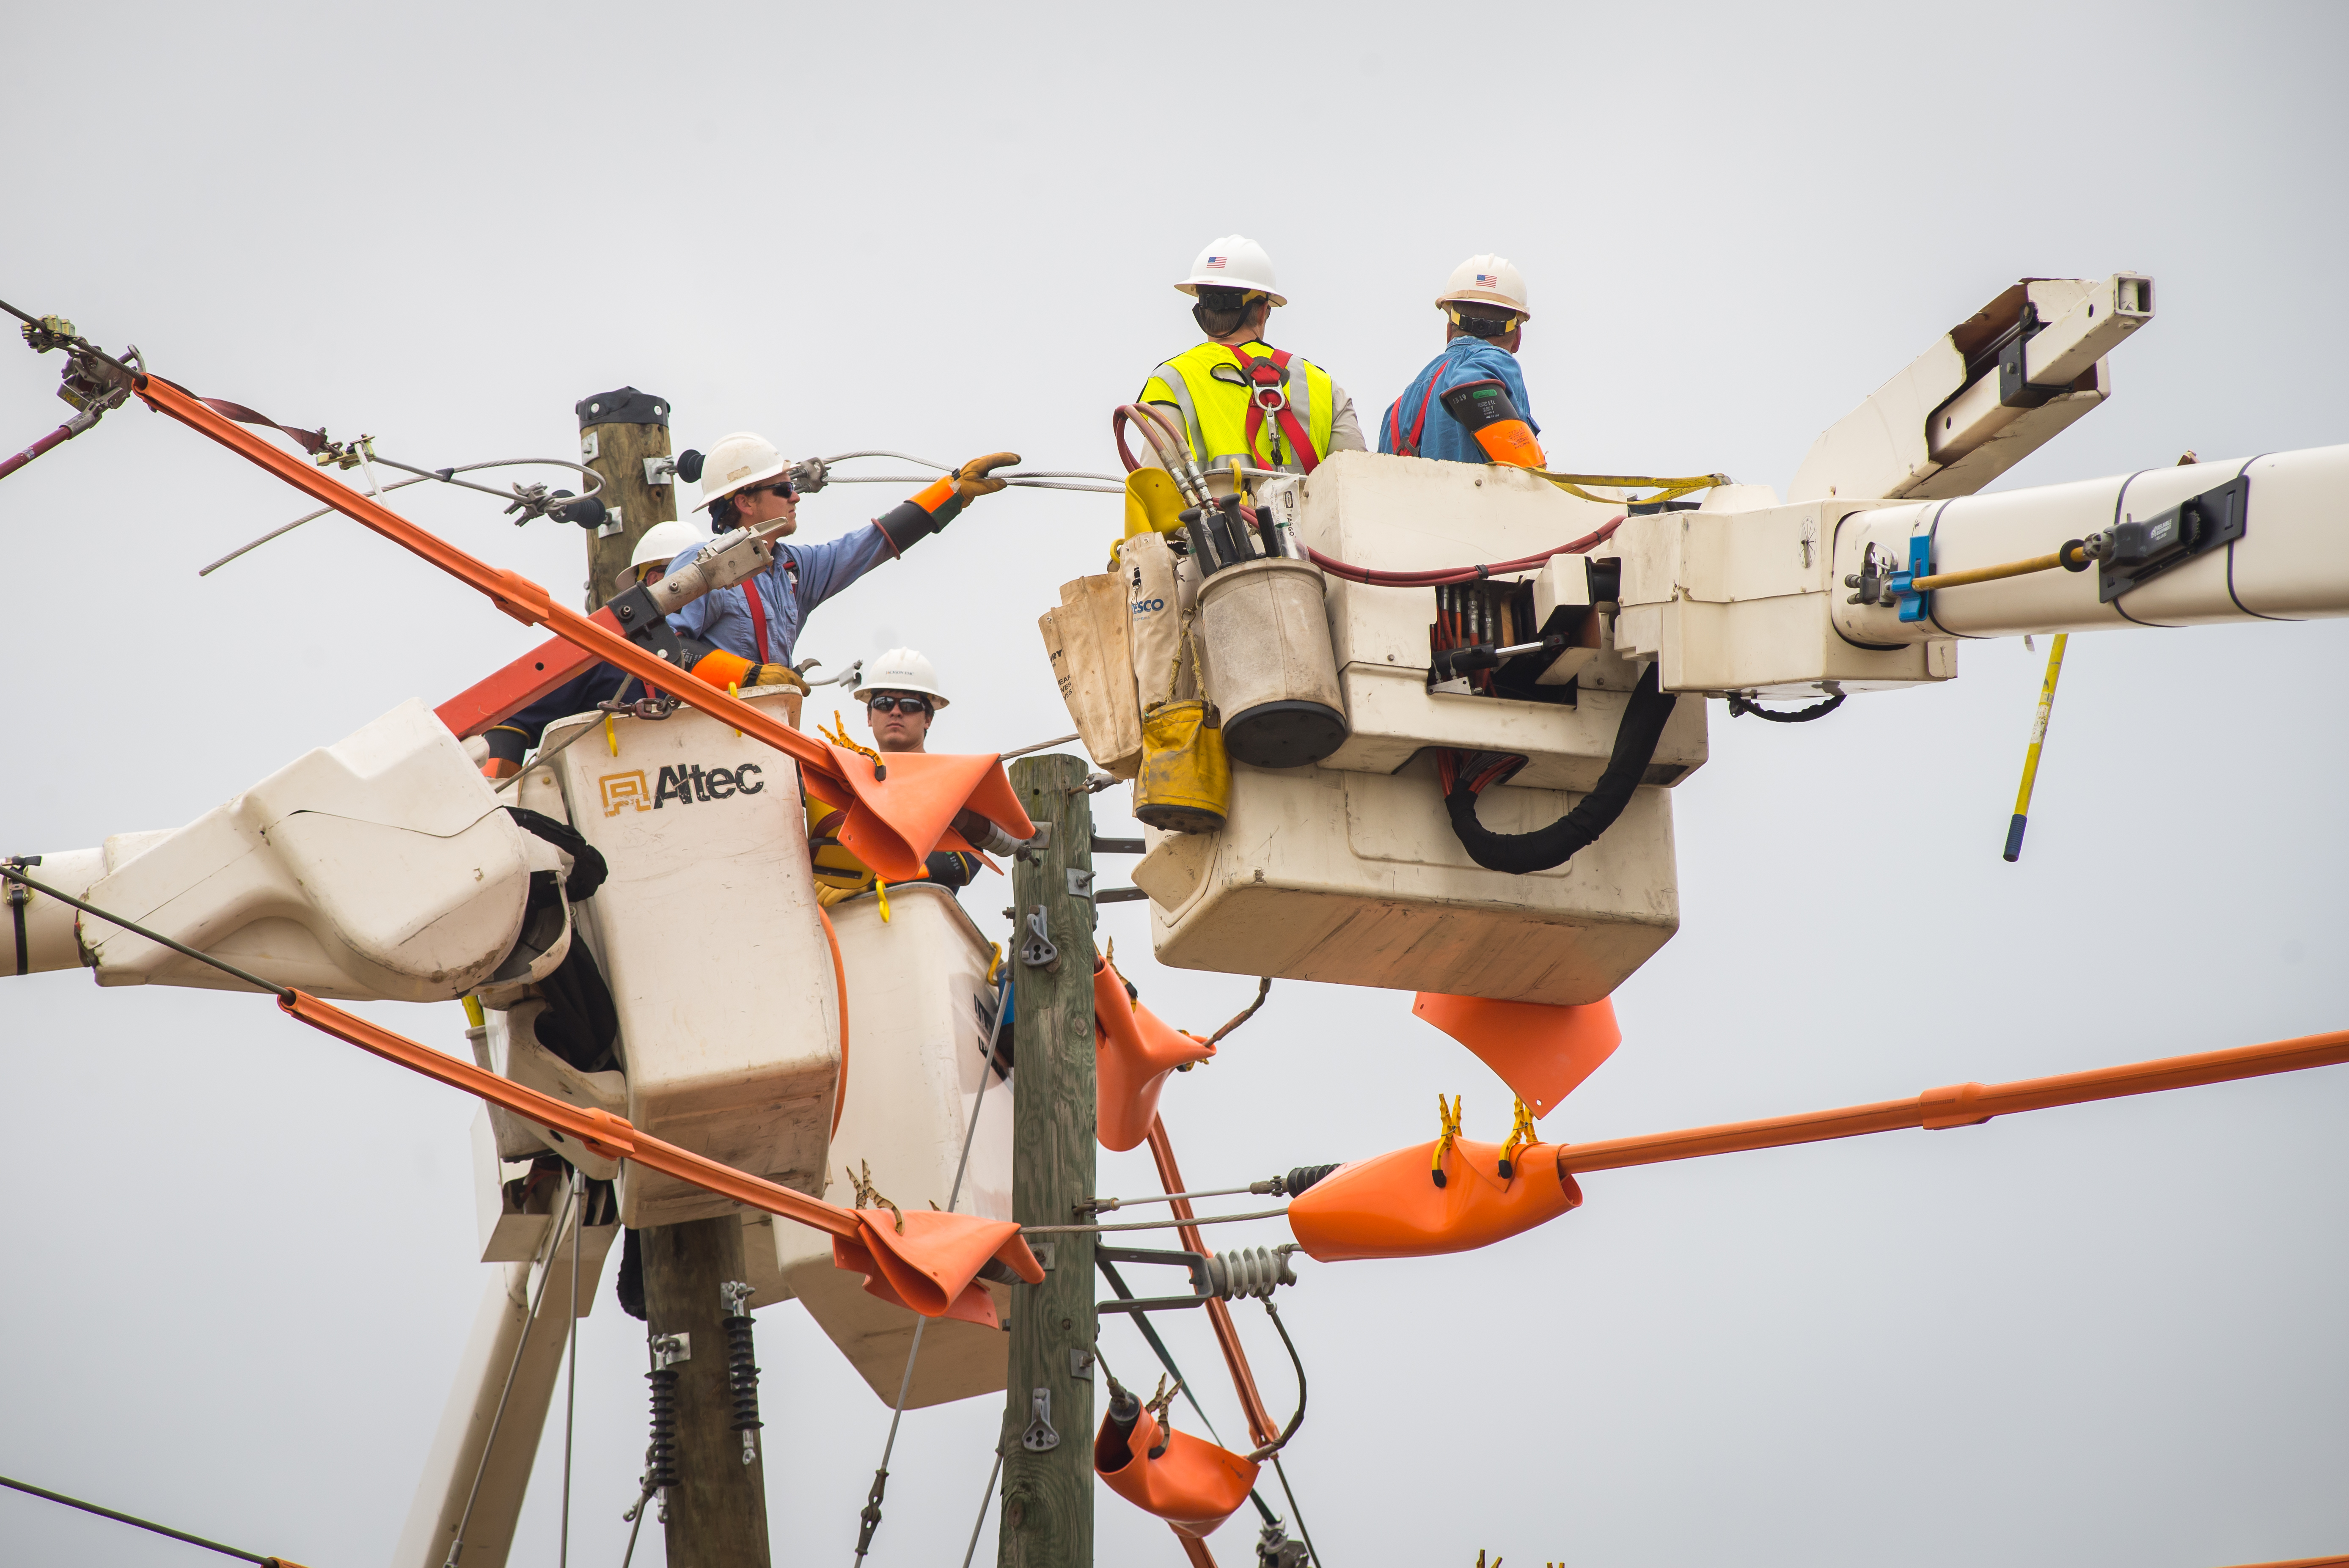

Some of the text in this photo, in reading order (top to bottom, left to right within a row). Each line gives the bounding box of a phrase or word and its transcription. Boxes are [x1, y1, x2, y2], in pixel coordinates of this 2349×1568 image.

[1452, 393, 1466, 404] 1319
[2157, 519, 2172, 531] RELIABLE
[2157, 524, 2172, 536] EQUIPMENT
[653, 763, 764, 809] Altec
[950, 856, 960, 870] 1788
